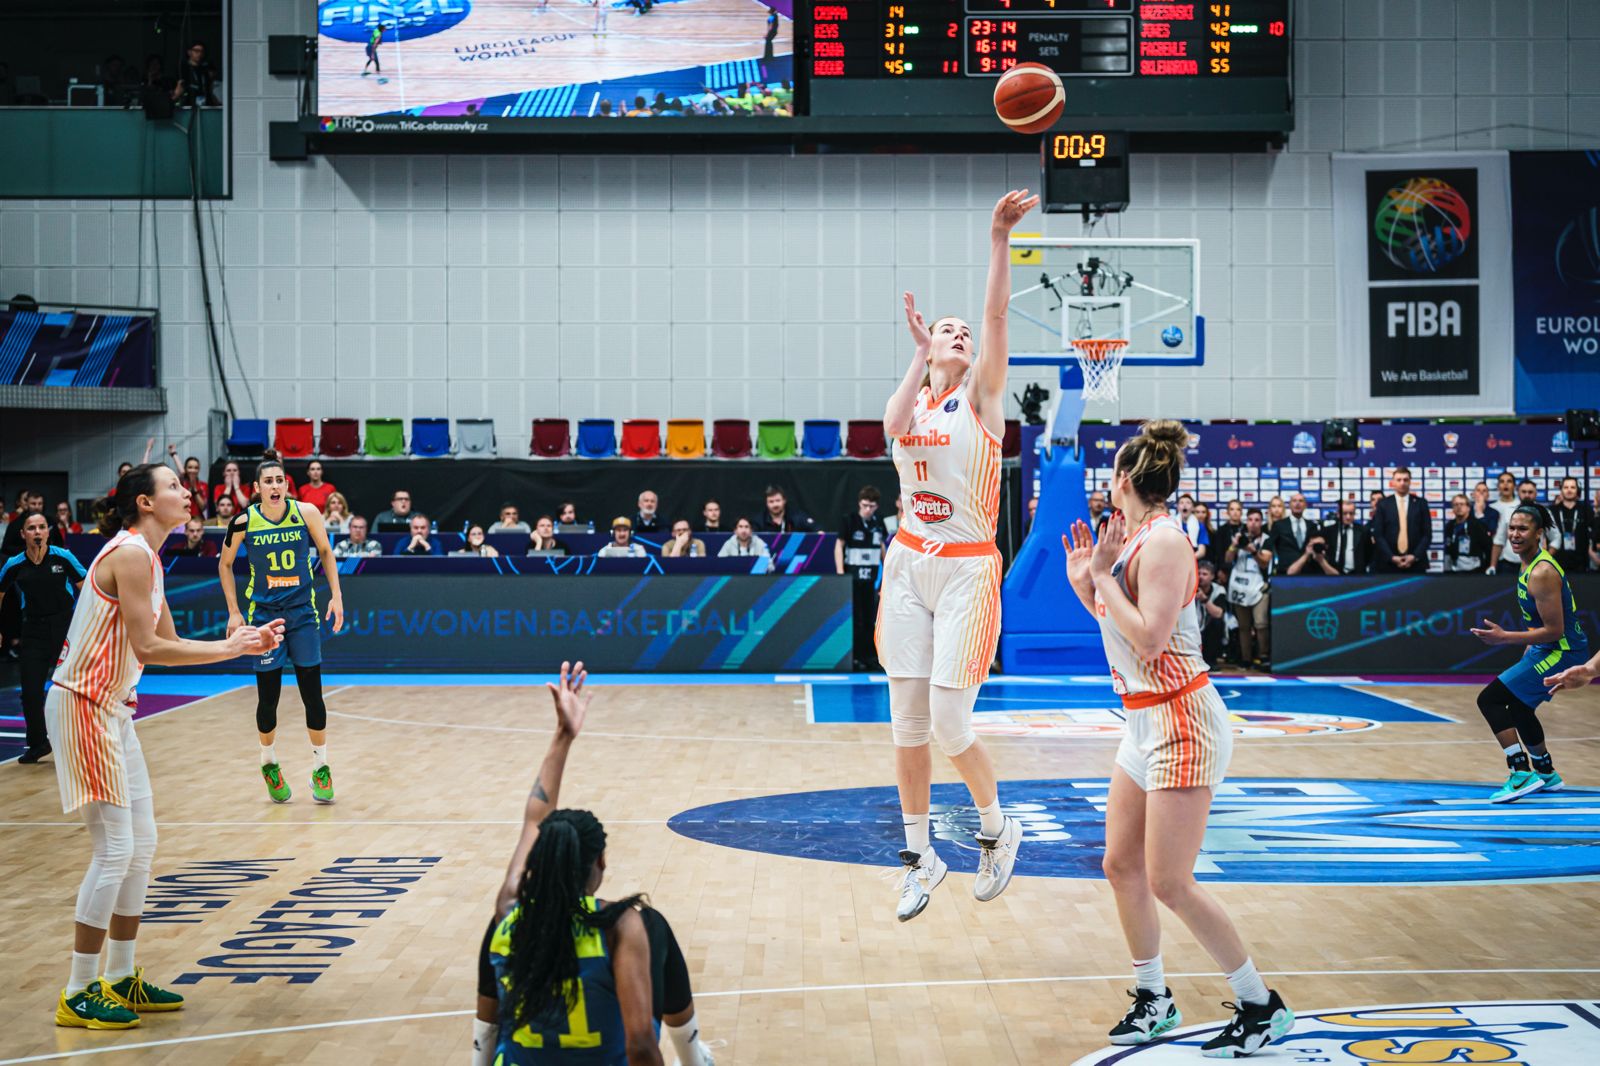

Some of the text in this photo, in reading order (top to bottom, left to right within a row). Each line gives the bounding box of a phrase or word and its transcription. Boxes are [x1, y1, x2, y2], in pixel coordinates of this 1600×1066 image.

[889, 5, 904, 19] 14
[1210, 4, 1231, 17] 41
[885, 23, 905, 38] 31
[947, 23, 958, 38] 2
[1210, 21, 1231, 37] 42
[1269, 21, 1285, 36] 10
[1028, 33, 1070, 43] PENALTY
[459, 47, 537, 63] WOMEN
[884, 42, 905, 55] 41
[1039, 47, 1060, 57] SETS
[1210, 41, 1231, 55] 44
[884, 60, 905, 75] 45
[1387, 300, 1462, 338] FIBA
[1381, 369, 1469, 383] We Are Basketball
[899, 428, 951, 448] amila
[914, 460, 929, 482] 11
[253, 531, 302, 546] ZVVZ USK
[266, 549, 296, 571] 10
[268, 578, 300, 590] prima
[139, 857, 297, 924] WOMEN
[170, 856, 444, 985] EUROLEAGUE
